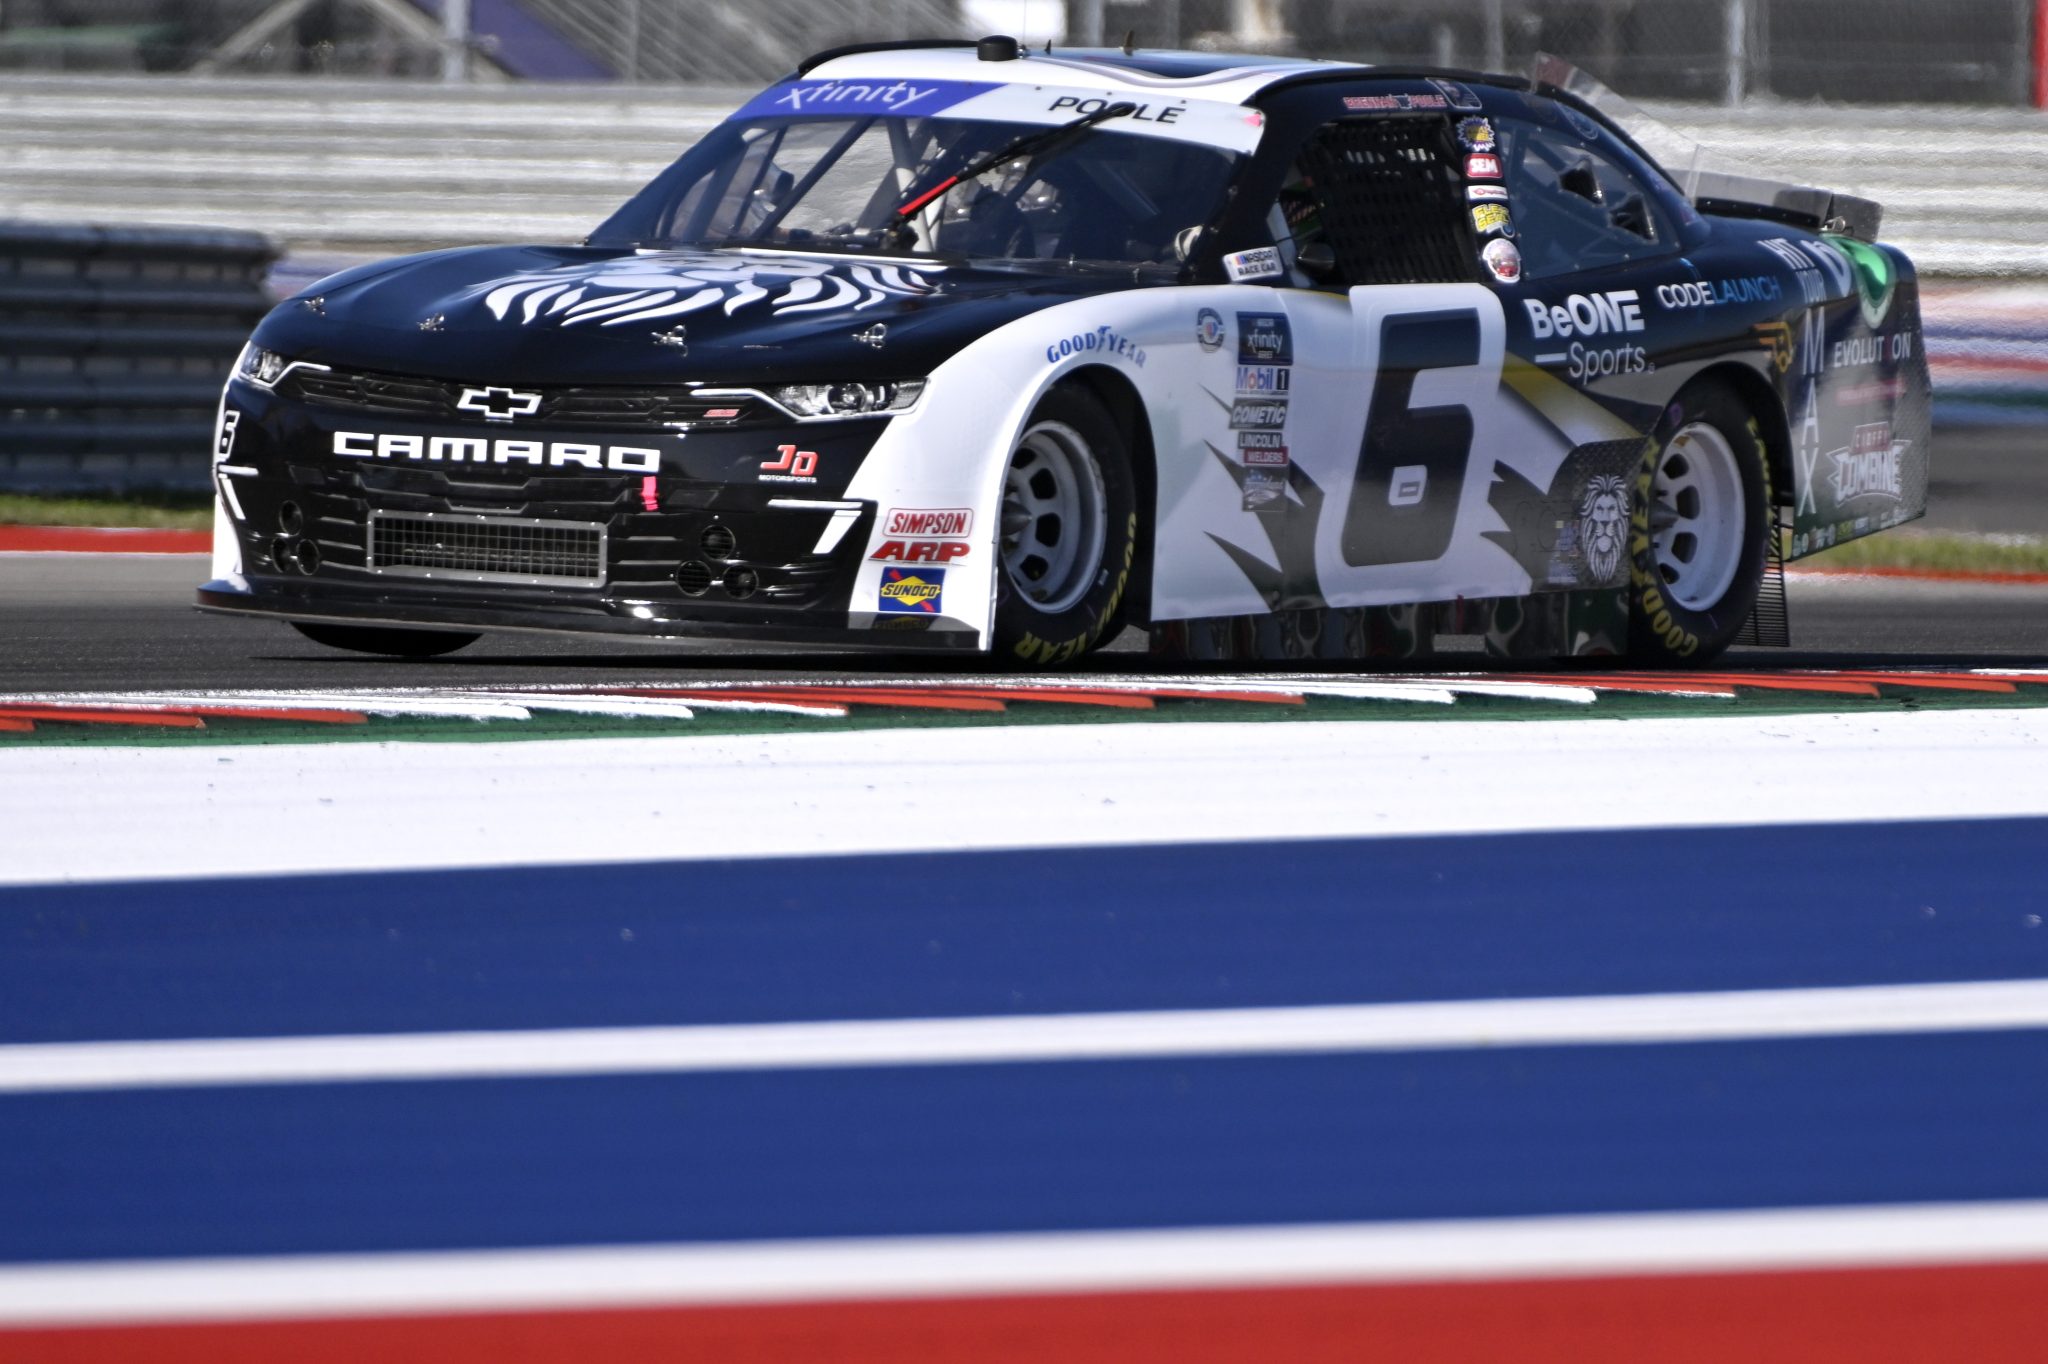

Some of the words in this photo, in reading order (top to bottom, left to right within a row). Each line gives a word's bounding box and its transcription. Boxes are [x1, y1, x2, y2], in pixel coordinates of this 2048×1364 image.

[775, 81, 939, 111] xfinity
[1047, 95, 1187, 124] POLE
[1469, 157, 1498, 174] SEM
[1237, 265, 1260, 276] RACE
[1261, 262, 1276, 272] CAR
[1657, 275, 1780, 308] CODELAUNCH
[1523, 289, 1645, 339] BeONE
[1247, 328, 1283, 354] xfinity
[1568, 341, 1646, 385] Sports
[1236, 366, 1273, 390] Mobil
[1231, 405, 1286, 424] COMETIC
[217, 409, 241, 462] 6
[1239, 434, 1281, 448] LINCOLN
[1341, 307, 1481, 567] 6
[333, 431, 661, 473] CAMARO
[1247, 452, 1284, 463] WELDERS
[758, 474, 817, 483] MOTORSPORTS
[890, 512, 967, 534] SIMPSON
[869, 540, 971, 563] ARP
[883, 583, 938, 597] SUNOCO
